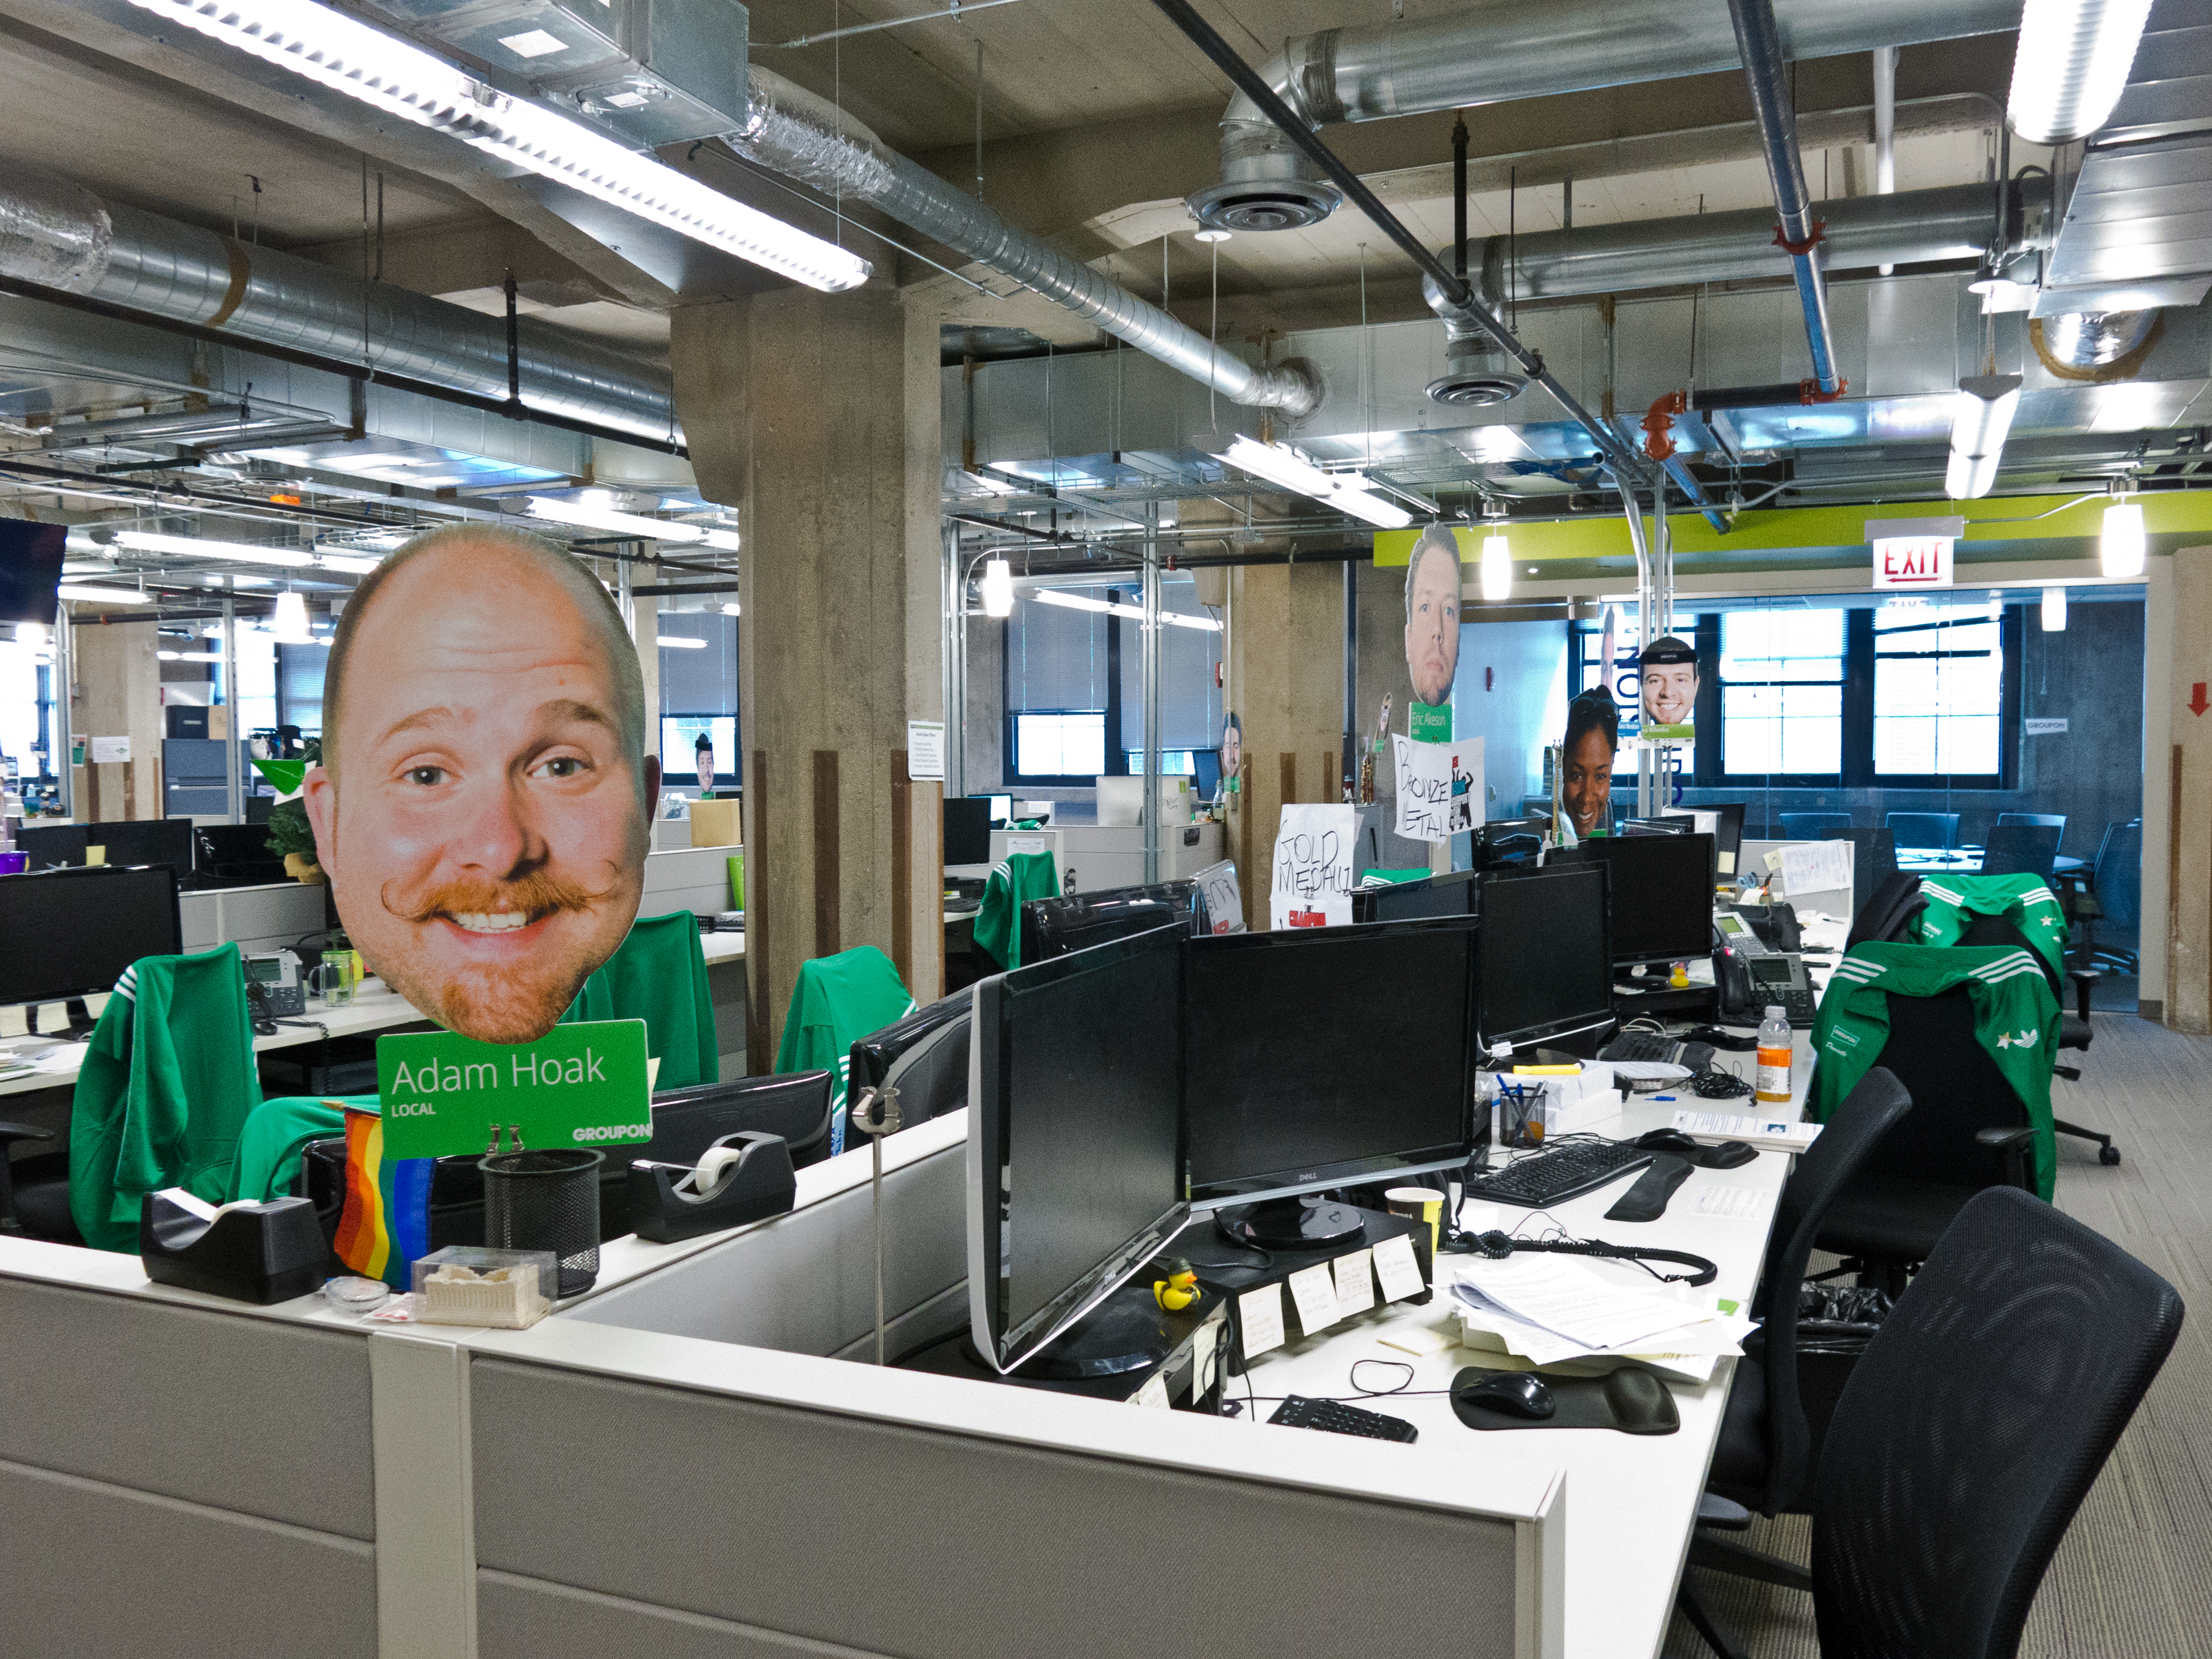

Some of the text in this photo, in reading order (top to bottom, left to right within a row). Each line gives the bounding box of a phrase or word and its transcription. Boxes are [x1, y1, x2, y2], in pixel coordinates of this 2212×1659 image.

[1885, 542, 1942, 575] EXIT
[1279, 819, 1339, 872] GOLD
[392, 1047, 606, 1094] Adam Hoak
[392, 1103, 436, 1117] LOCAL
[573, 1123, 651, 1141] GROUPON
[1300, 1172, 1317, 1181] DELL
